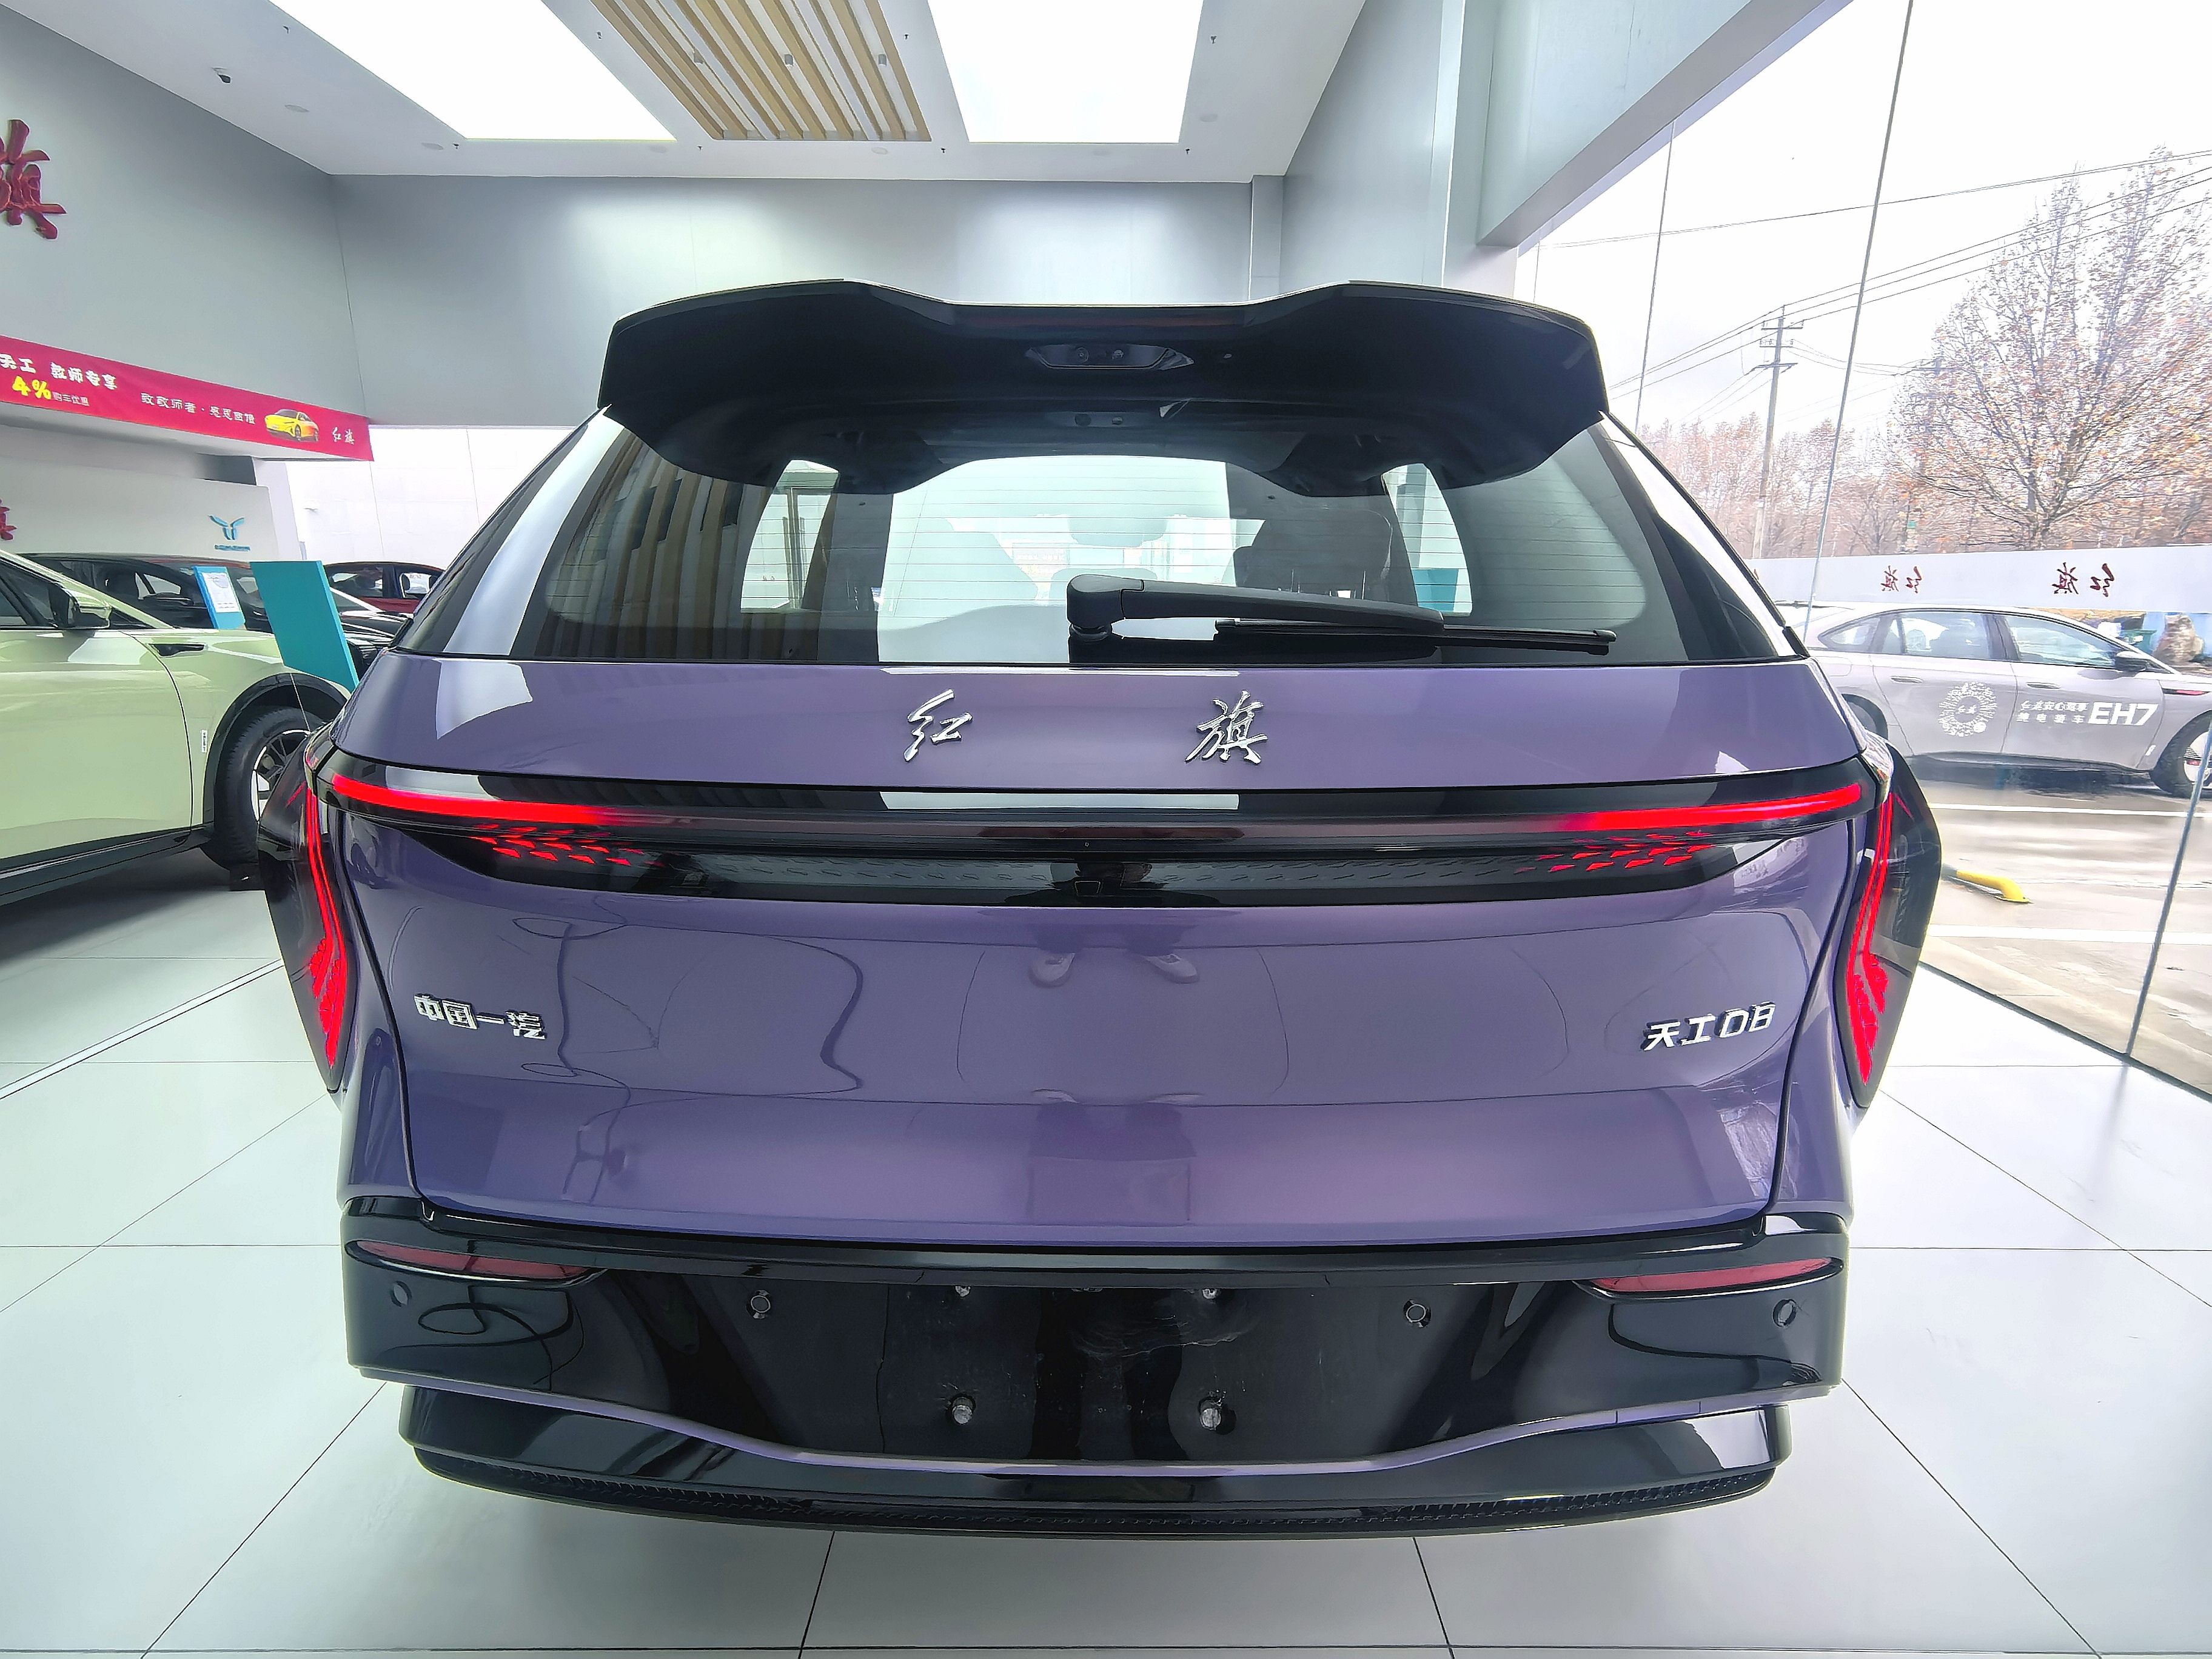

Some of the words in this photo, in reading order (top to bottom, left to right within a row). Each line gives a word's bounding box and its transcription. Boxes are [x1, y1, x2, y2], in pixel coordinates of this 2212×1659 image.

[12, 375, 52, 400] 4%
[332, 426, 355, 445] 红旗
[2088, 702, 2159, 725] EH7
[414, 993, 546, 1040] 中国一汽
[1639, 1000, 1776, 1052] 天工08
